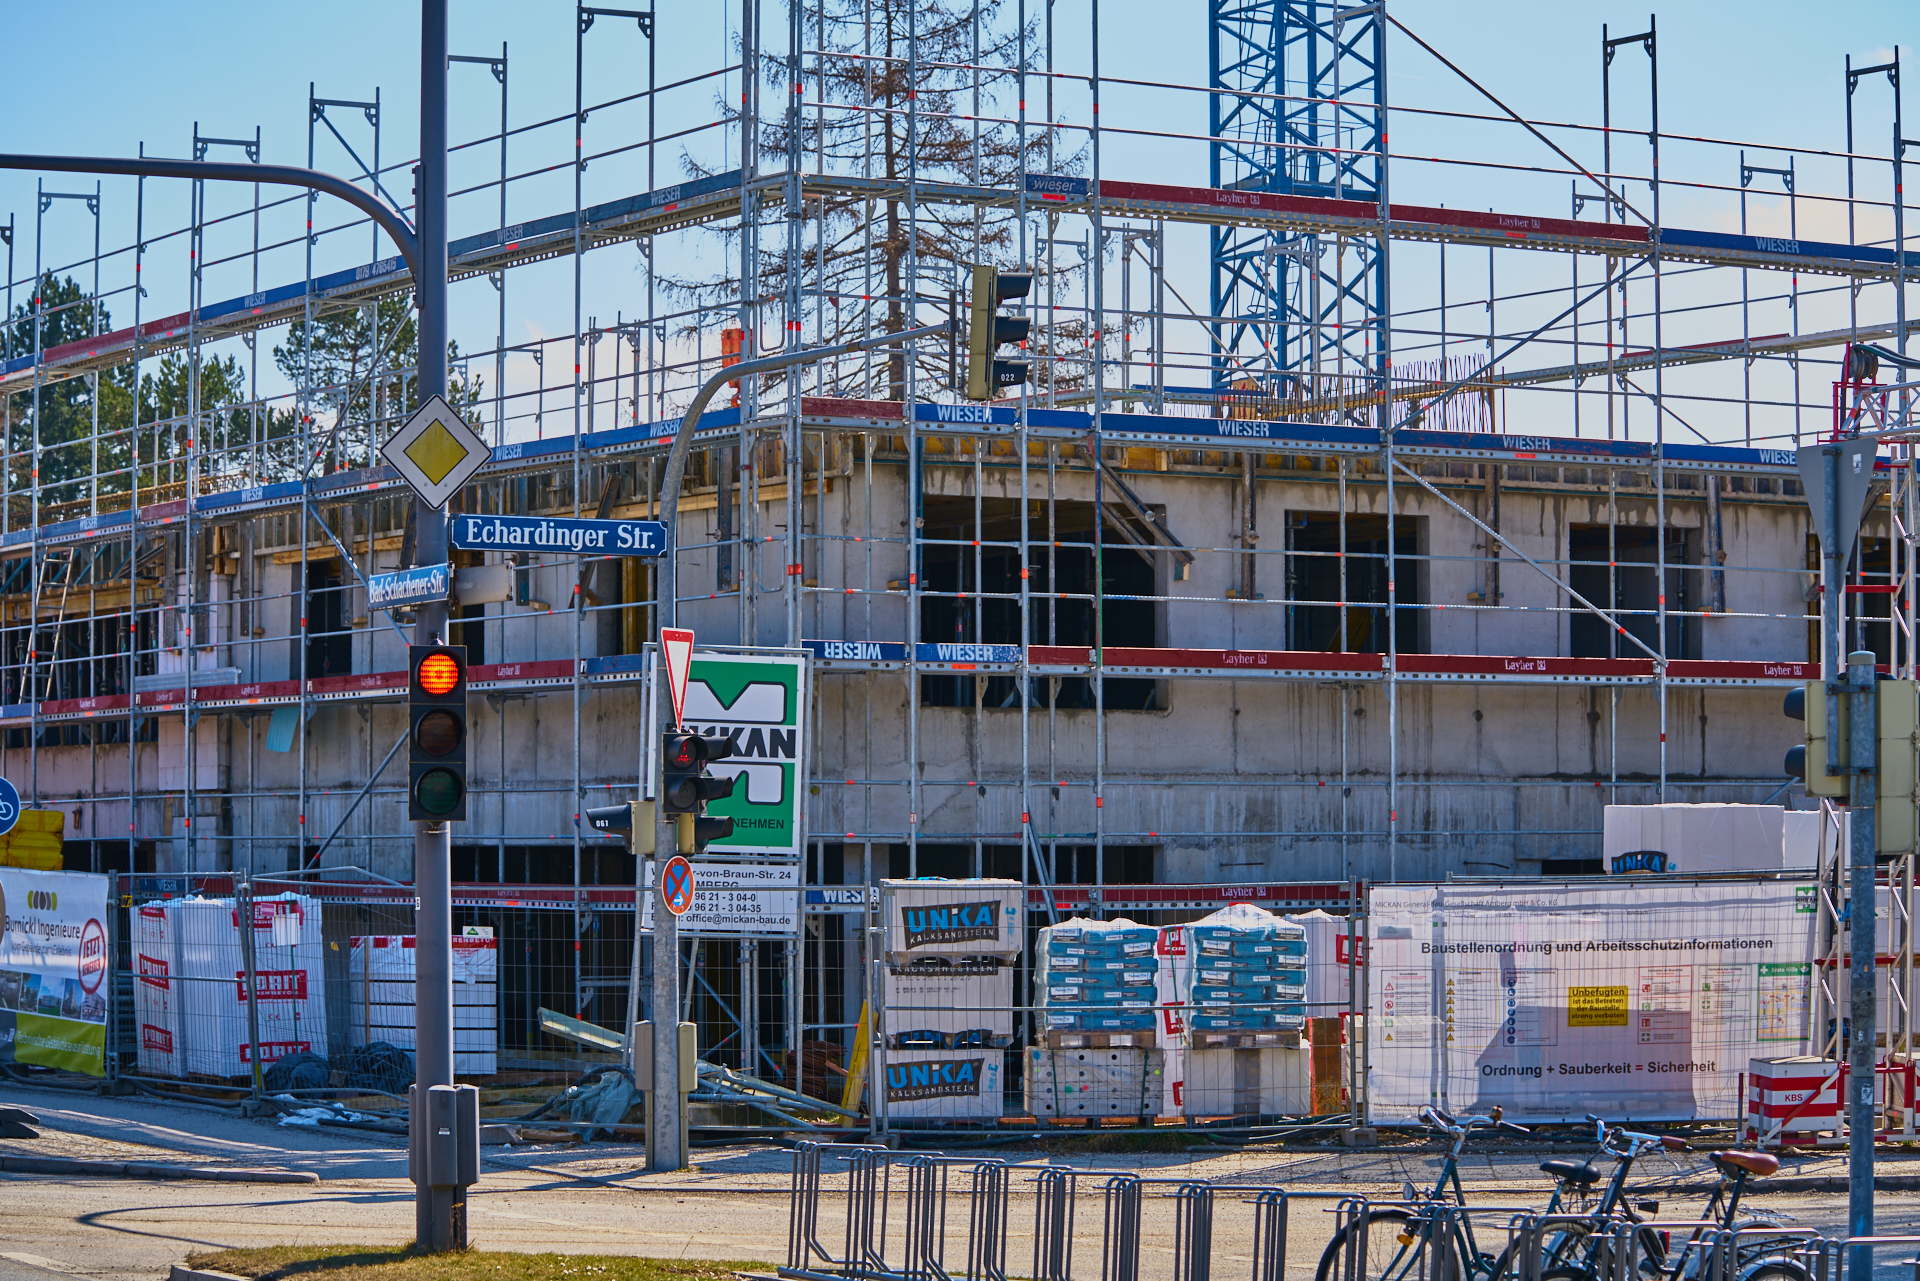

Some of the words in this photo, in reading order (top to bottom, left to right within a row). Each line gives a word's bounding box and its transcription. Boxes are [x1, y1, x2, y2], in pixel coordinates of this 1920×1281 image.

[1033, 178, 1076, 193] wieser
[650, 186, 681, 206] WIESER
[1216, 191, 1248, 205] Layher
[1499, 216, 1529, 228] Layher
[496, 225, 523, 243] WIESER
[1755, 237, 1801, 254] WIESER
[244, 291, 266, 309] WIESER
[1000, 373, 1015, 382] 022
[936, 404, 993, 423] WIESER
[650, 419, 681, 437] WIESER
[1217, 420, 1270, 437] WIESER
[1502, 435, 1551, 451] WIESER
[496, 443, 522, 460] WIESER
[1759, 449, 1797, 465] WIESE
[241, 486, 263, 503] WIESER
[79, 517, 98, 530] WIESER
[466, 518, 609, 551] Echardinger
[616, 524, 657, 550] Str.
[369, 569, 446, 604] Bad-Schachener-Str.
[824, 642, 882, 660] WIESER
[937, 644, 994, 662] WIESER
[1222, 653, 1255, 666] Layher
[1504, 660, 1535, 671] Layher
[1764, 665, 1792, 676] Layher
[596, 819, 609, 827] 061
[778, 871, 792, 880] 24
[157, 879, 178, 891] WIESER
[695, 893, 706, 901] 96
[708, 893, 719, 901] 21
[728, 893, 734, 901] 3
[736, 893, 756, 902] 04-0
[822, 887, 880, 904] WIESR
[695, 904, 706, 912] 96
[708, 904, 719, 912] 21
[728, 904, 734, 912] 3
[736, 904, 762, 913] 04-35
[686, 914, 791, 925] office@mickan-bau.de
[5, 915, 36, 935] Burnickl
[37, 918, 81, 941] Ingenieure
[910, 929, 994, 944] KALKSANDSTEIN
[82, 935, 101, 960] JETZT
[1421, 942, 1552, 955] Baustellenordnung
[1556, 941, 1582, 952] und
[1586, 937, 1773, 953] Arbeitsschutzinformationen
[1572, 988, 1625, 998] Unbefugten
[1589, 1004, 1620, 1012] Baustelle
[1482, 1064, 1543, 1077] Ordnung
[1559, 1061, 1632, 1076] Sauberkeit
[1647, 1060, 1716, 1074] Sicherheit
[890, 1085, 975, 1098] KALKSANDSTEIN
[1784, 1094, 1803, 1102] KBS
